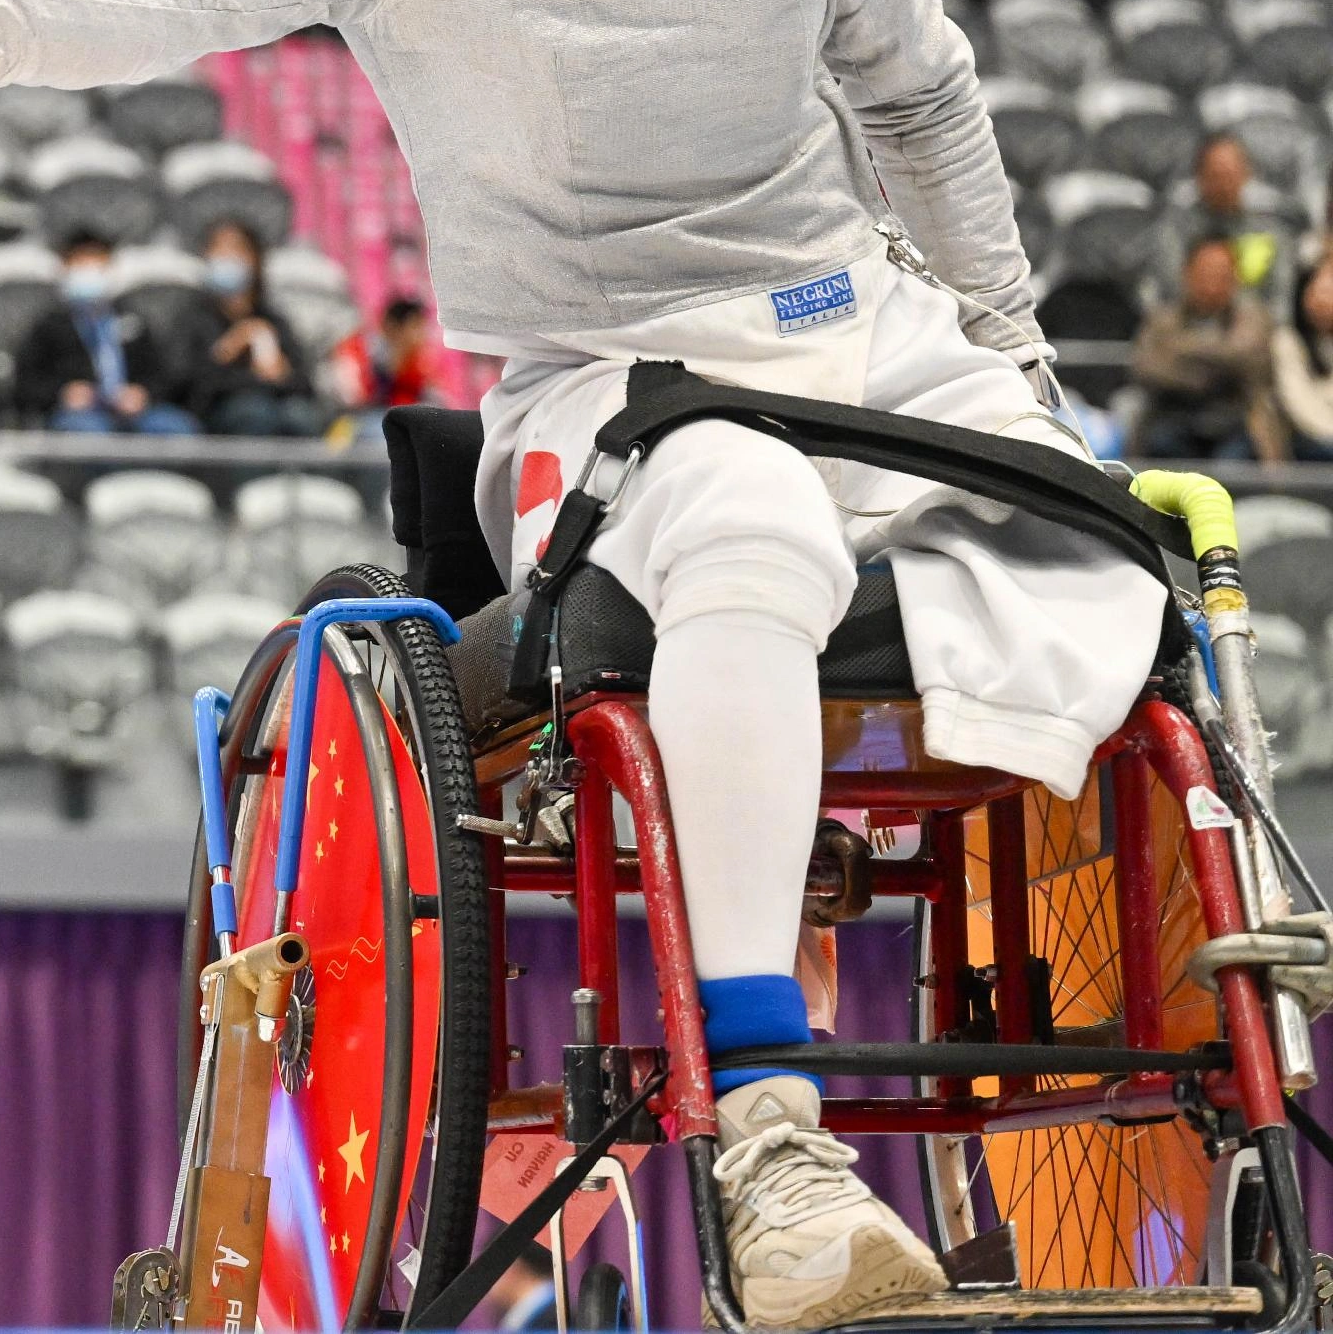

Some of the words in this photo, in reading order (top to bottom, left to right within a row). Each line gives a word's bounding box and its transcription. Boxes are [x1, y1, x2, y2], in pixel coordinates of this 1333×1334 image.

[775, 275, 851, 310] NEGRINI
[780, 300, 828, 318] FENCING
[787, 306, 851, 330] ITALIA
